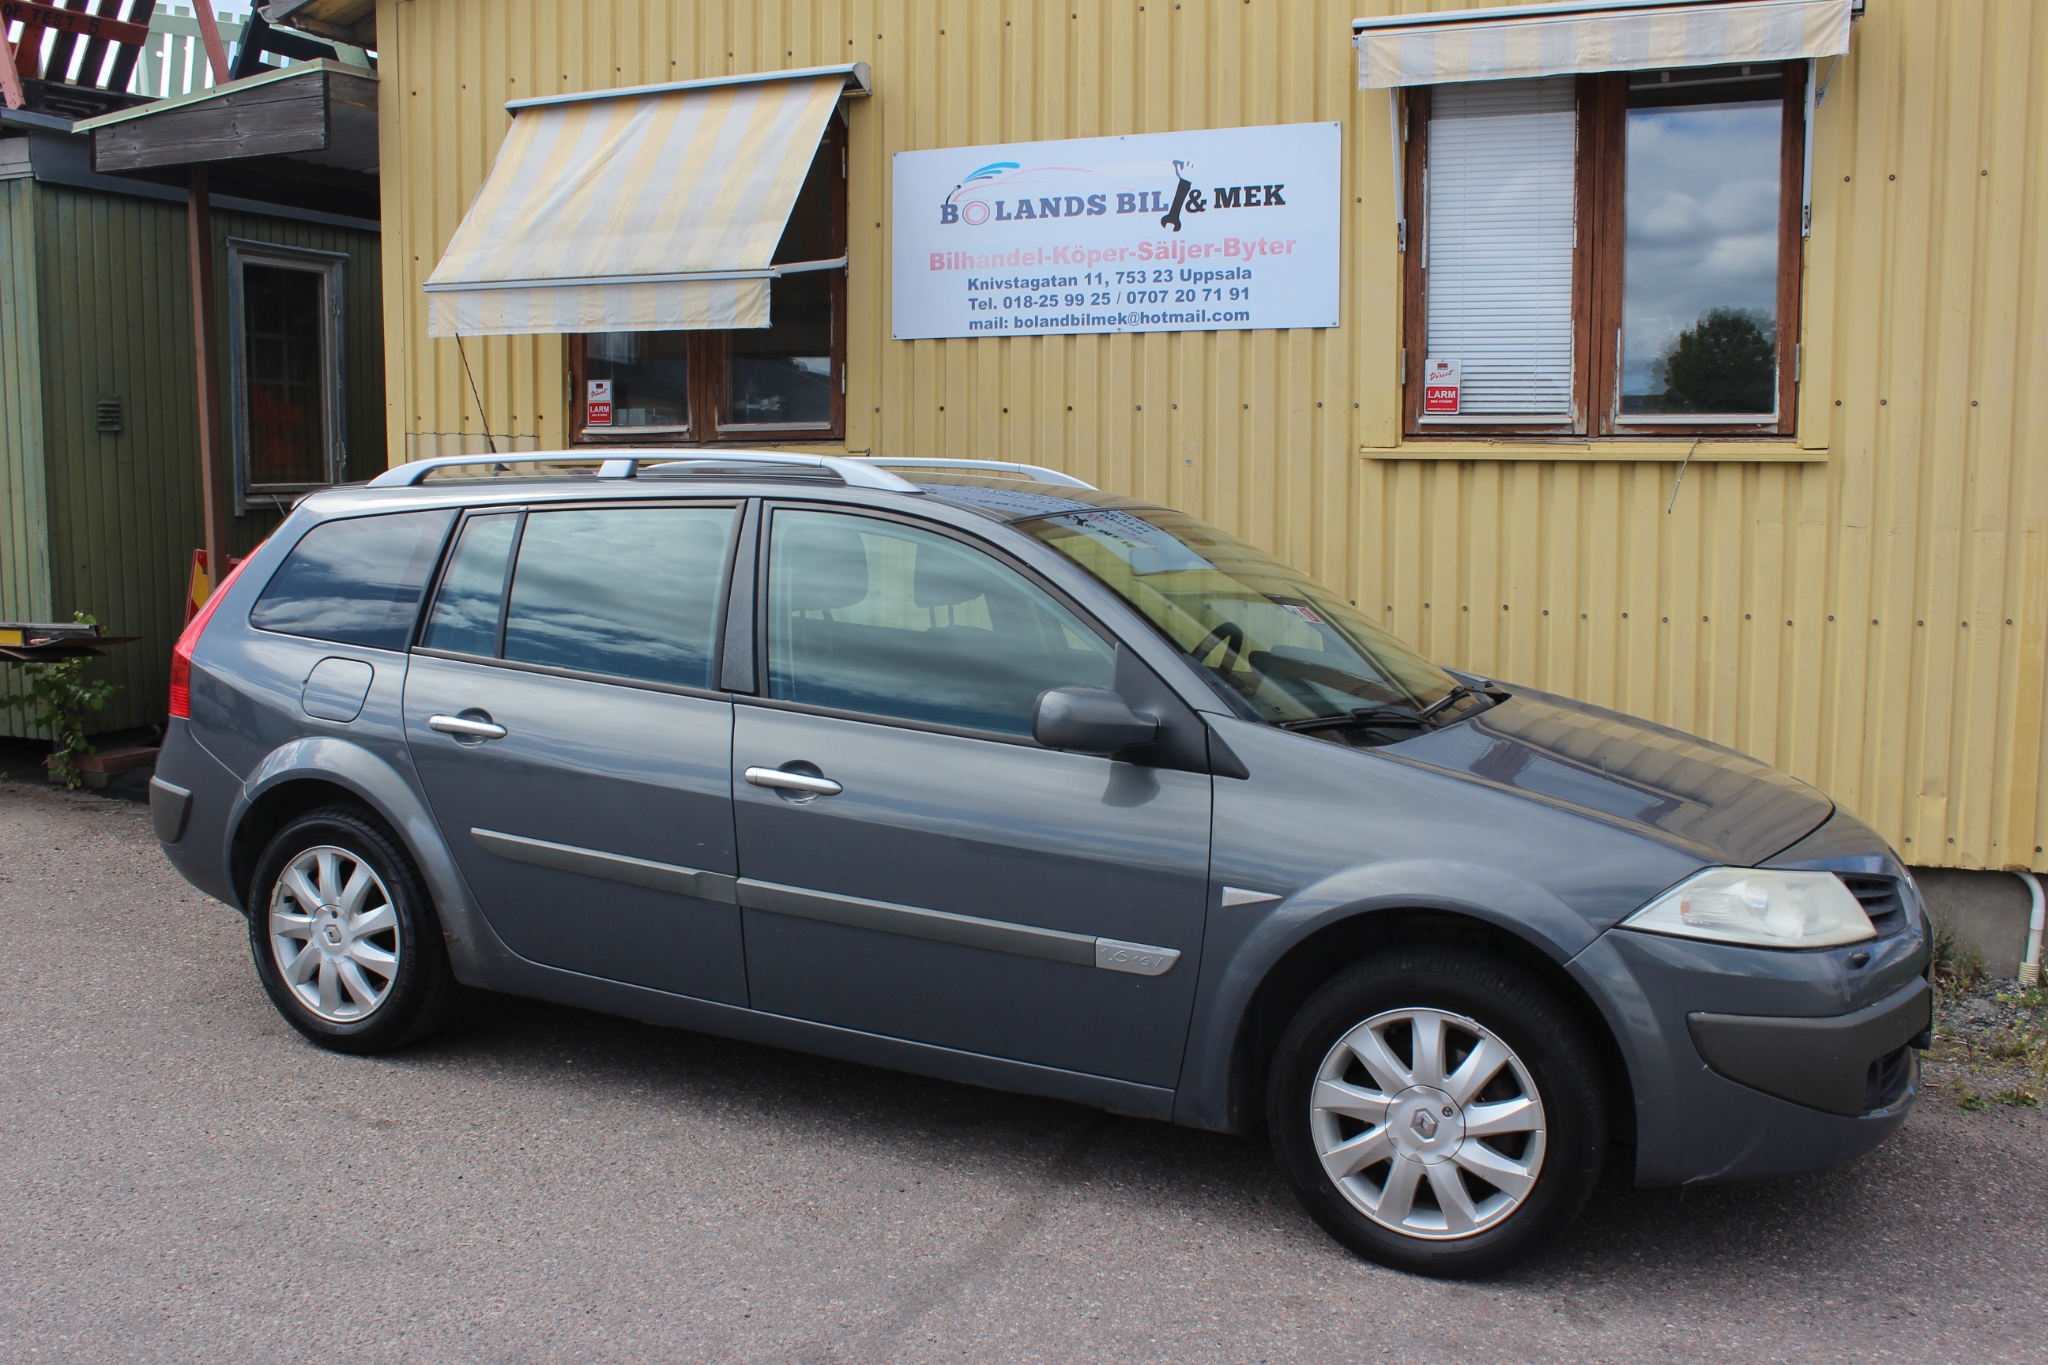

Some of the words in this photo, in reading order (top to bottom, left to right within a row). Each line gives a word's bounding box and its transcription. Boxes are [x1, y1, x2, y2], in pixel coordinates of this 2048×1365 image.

[30, 8, 75, 28] TEST
[940, 194, 1107, 226] BOLANDS
[1116, 191, 1169, 214] BIL
[1185, 189, 1207, 213] &
[1213, 184, 1286, 209] MEK
[929, 236, 1297, 271] Bilhandel-Köper-Säljer-Byter
[967, 275, 1078, 291] Knivstagatan
[1084, 271, 1109, 287] 11,
[1115, 270, 1147, 285] 753
[1152, 269, 1174, 283] 23
[1179, 267, 1252, 284] Uppsala
[968, 297, 998, 310] Tel.
[1003, 294, 1059, 309] 018-25
[1064, 293, 1085, 307] 99
[1090, 292, 1111, 306] 25
[1126, 290, 1169, 305] 0707
[1174, 289, 1196, 303] 20
[1202, 287, 1222, 302] 71
[1229, 286, 1249, 301] 91
[969, 316, 1009, 330] mail:
[1014, 310, 1250, 329] bolandbilmek@hotmail.com
[1427, 390, 1456, 399] LARM
[589, 405, 610, 413] LARM
[1133, 955, 1164, 967] 16V
